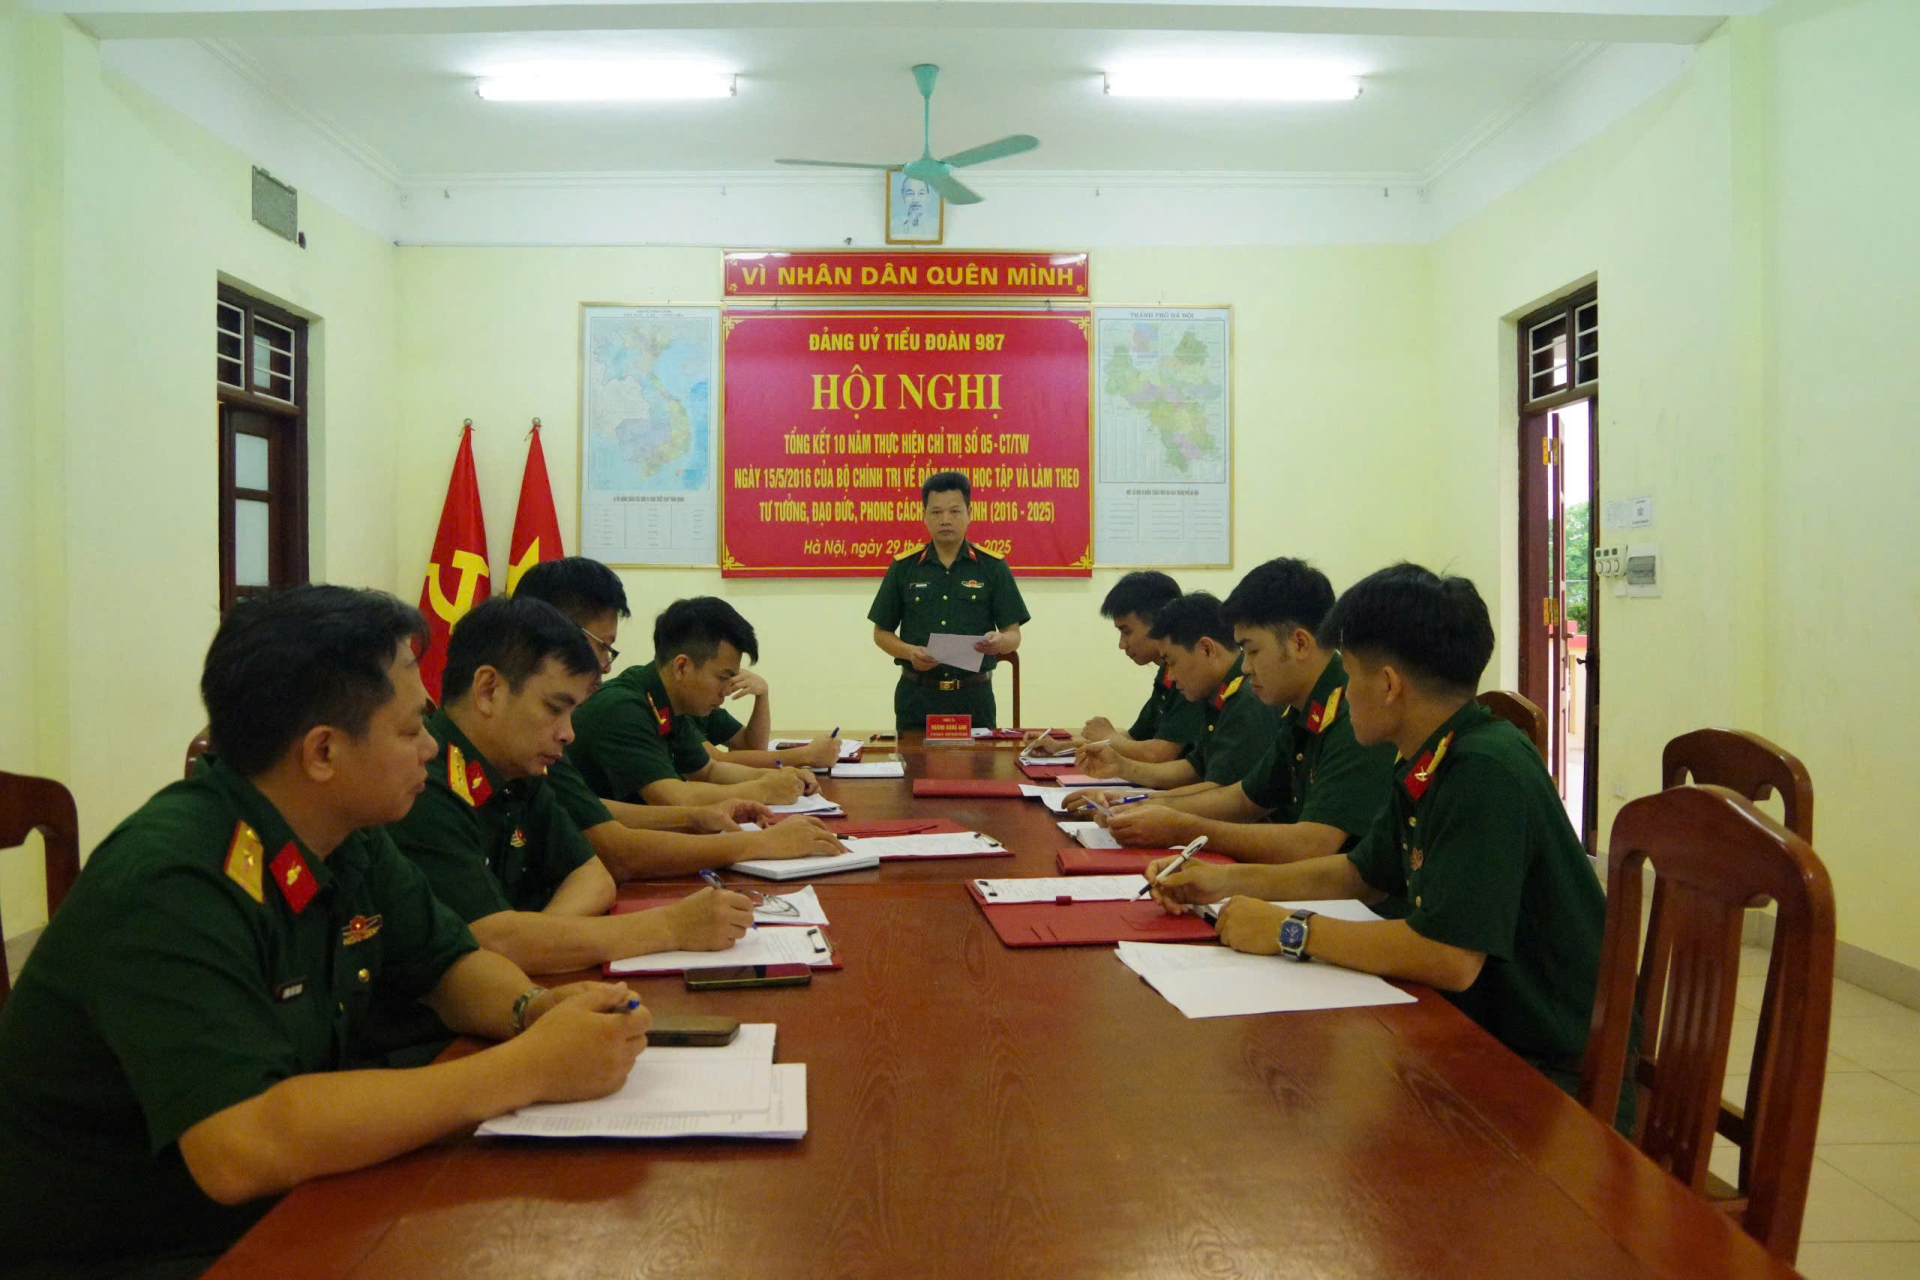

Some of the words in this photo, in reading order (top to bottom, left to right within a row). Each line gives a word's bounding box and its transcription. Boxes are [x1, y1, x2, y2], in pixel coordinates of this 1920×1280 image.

[741, 263, 766, 286] VÌ
[778, 263, 852, 286] NHÂN
[861, 263, 917, 285] DÂN
[926, 263, 998, 286] QUÊN
[1007, 263, 1073, 286] MÌNH
[809, 326, 855, 351] ĐẢNG
[859, 326, 881, 351] UỶ
[885, 326, 920, 351] TIỂU
[925, 329, 970, 351] ĐOÀN
[975, 333, 1005, 351] 987
[811, 363, 887, 420] HỘI
[898, 373, 1002, 420] NGHỊ
[784, 426, 810, 454] TỔNG
[812, 426, 831, 454] KẾT
[834, 434, 846, 454] 10
[848, 430, 871, 454] NĂM
[874, 432, 899, 458] THỰC
[901, 429, 925, 458] HIỆN
[927, 426, 944, 454] CHỈ
[947, 434, 962, 458] THỊ
[965, 426, 979, 454] SỐ
[734, 464, 760, 488] NGÀY
[764, 468, 811, 488] 15/5/2016
[814, 459, 834, 488] CỦA
[836, 464, 850, 492] BỘ
[852, 463, 883, 488] CHÍNH
[885, 468, 901, 492] TRỊ
[903, 460, 916, 488] VỀ
[972, 468, 992, 492] HỌC
[995, 463, 1014, 492] TẬP
[1016, 463, 1029, 488] VÀ
[1031, 463, 1053, 488] LÀM
[1055, 467, 1079, 488] THEO
[759, 500, 773, 521] TƯ
[774, 493, 809, 524] TƯỞNG,
[812, 502, 832, 526] ĐẠO
[834, 496, 858, 524] ĐỨC,
[860, 502, 894, 521] PHONG
[896, 497, 923, 521] CÁCH
[990, 501, 1018, 523] (2016
[1027, 501, 1055, 523] 2025)
[803, 539, 821, 554] Hà
[824, 539, 847, 557] Nội,
[851, 538, 882, 558] ngày
[885, 540, 901, 554] 29
[983, 540, 1011, 554] 2025
